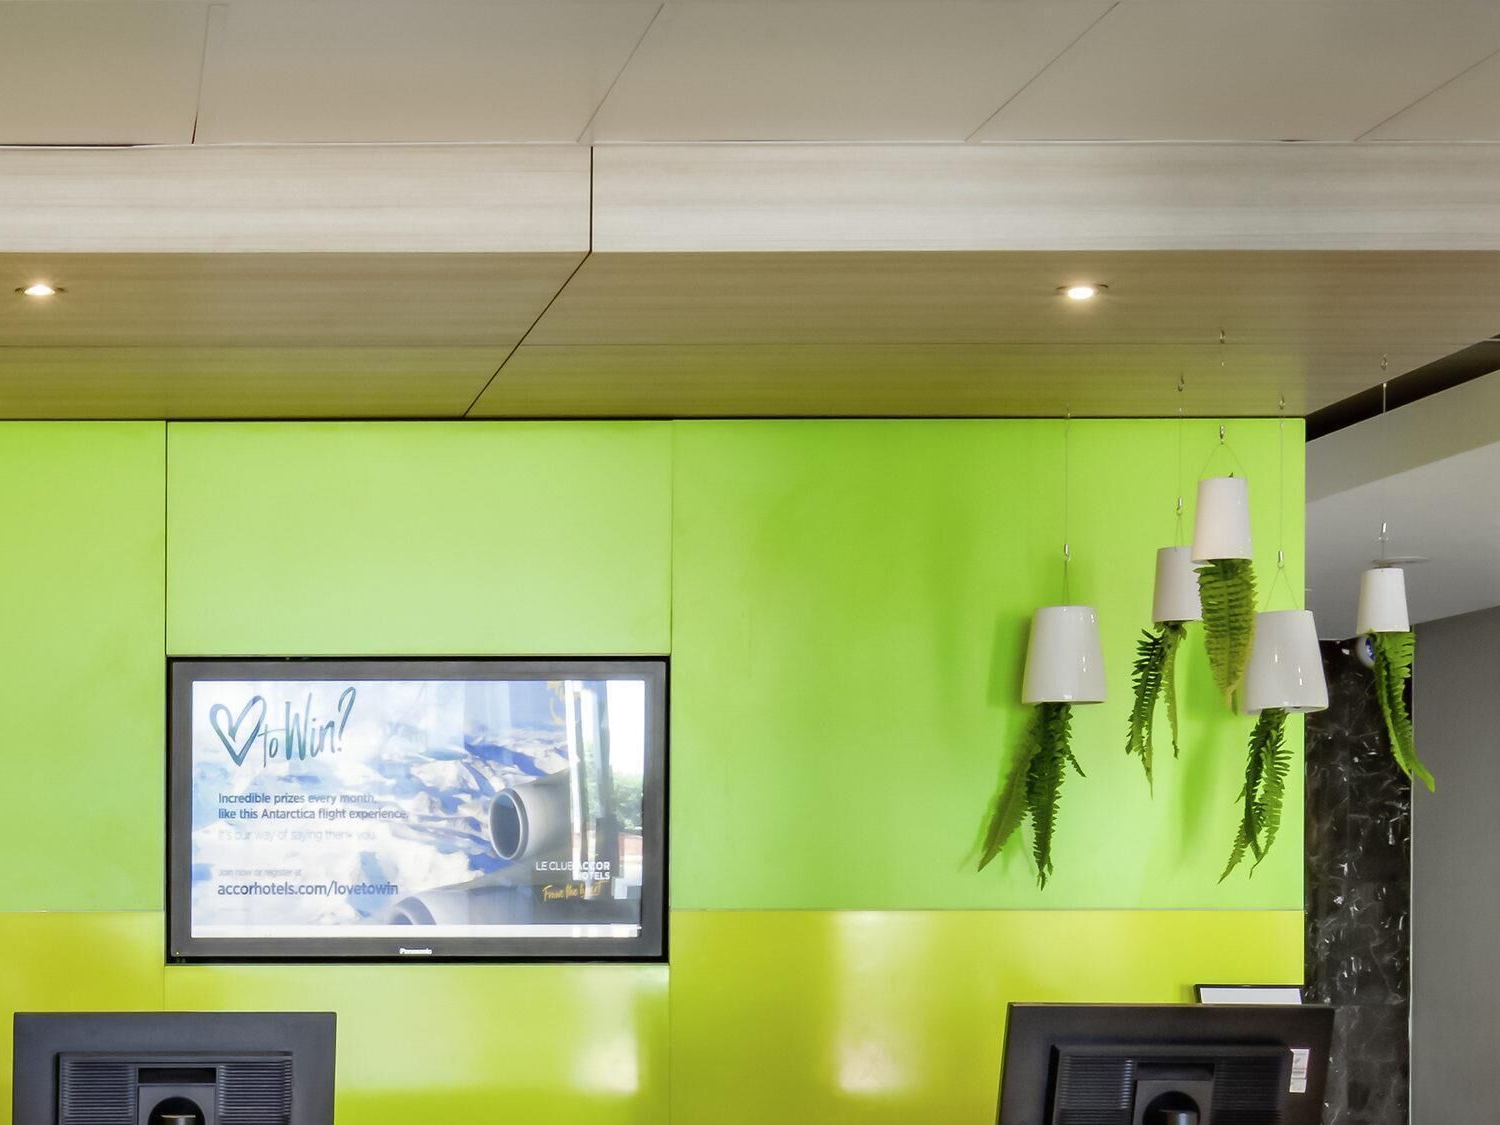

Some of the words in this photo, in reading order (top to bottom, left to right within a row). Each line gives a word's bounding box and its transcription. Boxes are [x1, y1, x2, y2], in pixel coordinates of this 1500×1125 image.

[258, 723, 285, 768] to
[285, 686, 357, 761] Win?
[218, 793, 272, 804] Incredible
[274, 793, 306, 806] prizes
[308, 795, 337, 805] every
[218, 808, 236, 819] like
[239, 808, 258, 819] this
[261, 808, 315, 819] Antarctica
[318, 808, 347, 820] flight
[218, 829, 232, 841] It's
[235, 831, 252, 841] our
[255, 831, 275, 843] way
[277, 829, 288, 841] of
[291, 829, 323, 843] saying
[535, 861, 548, 871] LE
[549, 861, 573, 871] CLUB
[217, 880, 399, 897] accorhotels.com/lovetowin
